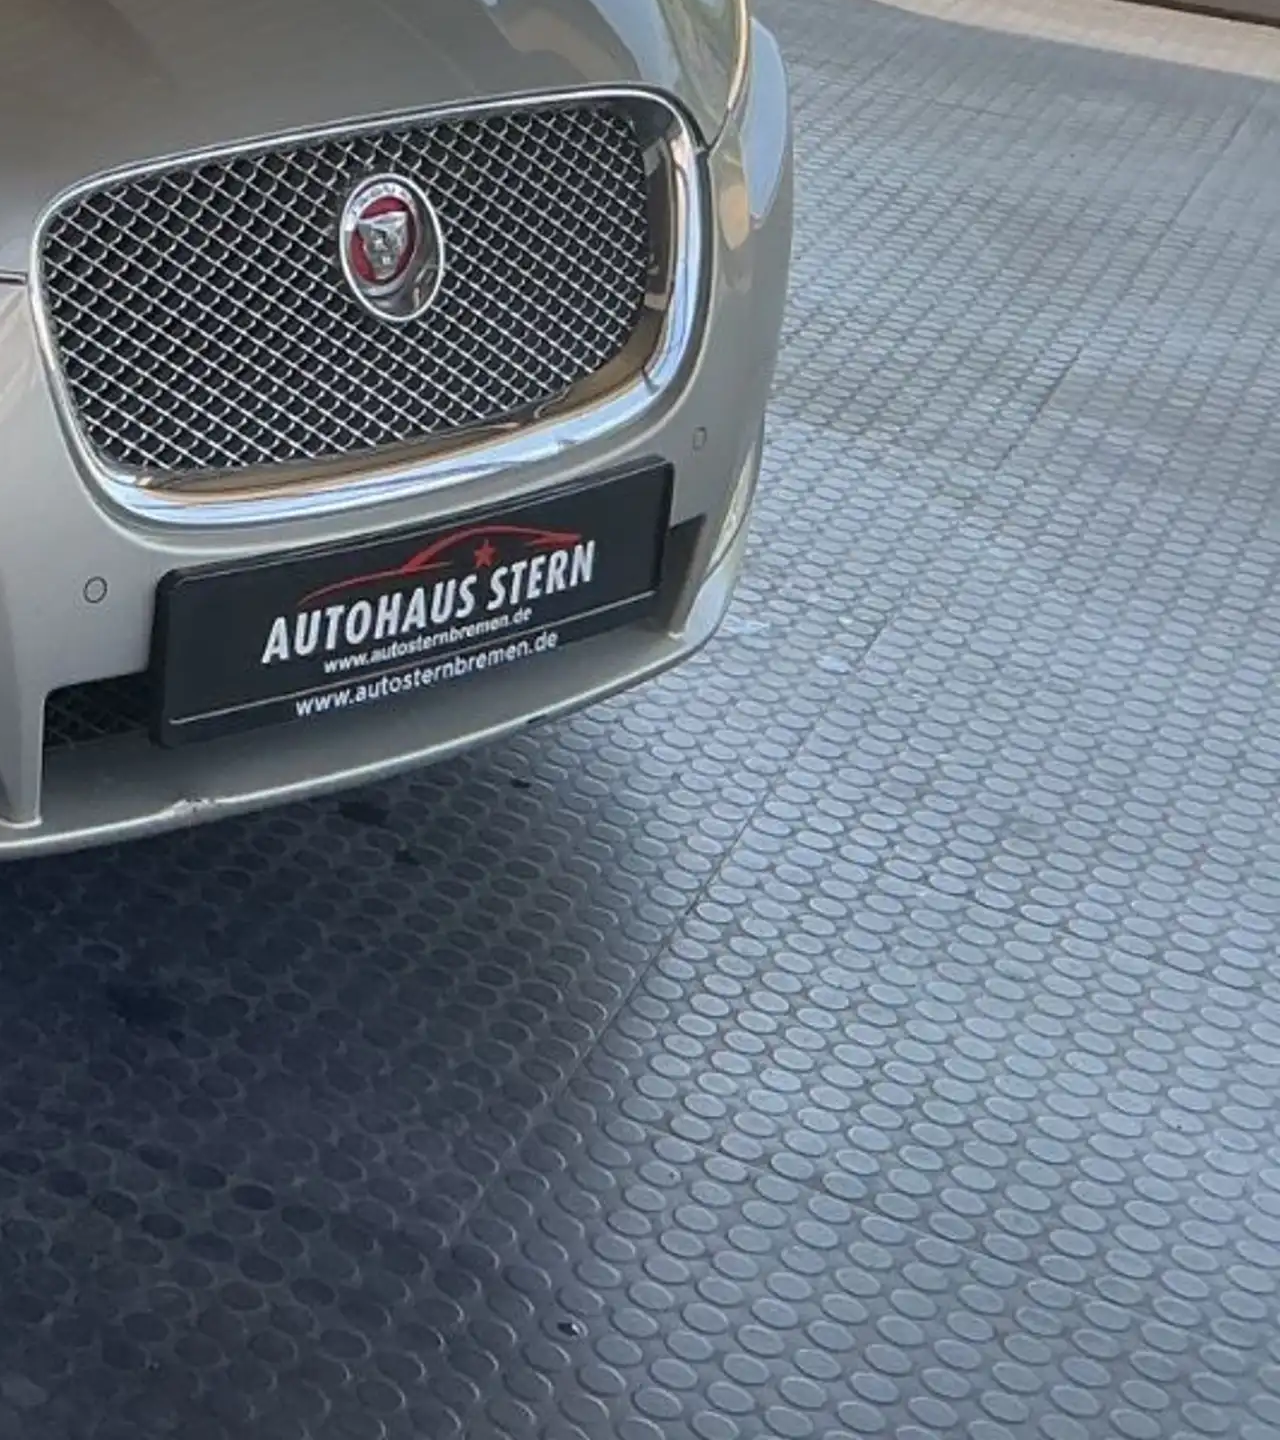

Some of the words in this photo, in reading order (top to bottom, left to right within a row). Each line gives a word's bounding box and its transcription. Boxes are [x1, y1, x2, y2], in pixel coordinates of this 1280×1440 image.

[260, 574, 475, 665] AUTOHAUS
[487, 540, 595, 613] STERN
[323, 606, 533, 675] www.autosternbremen.de
[295, 629, 558, 717] www.autosternbremen.de
